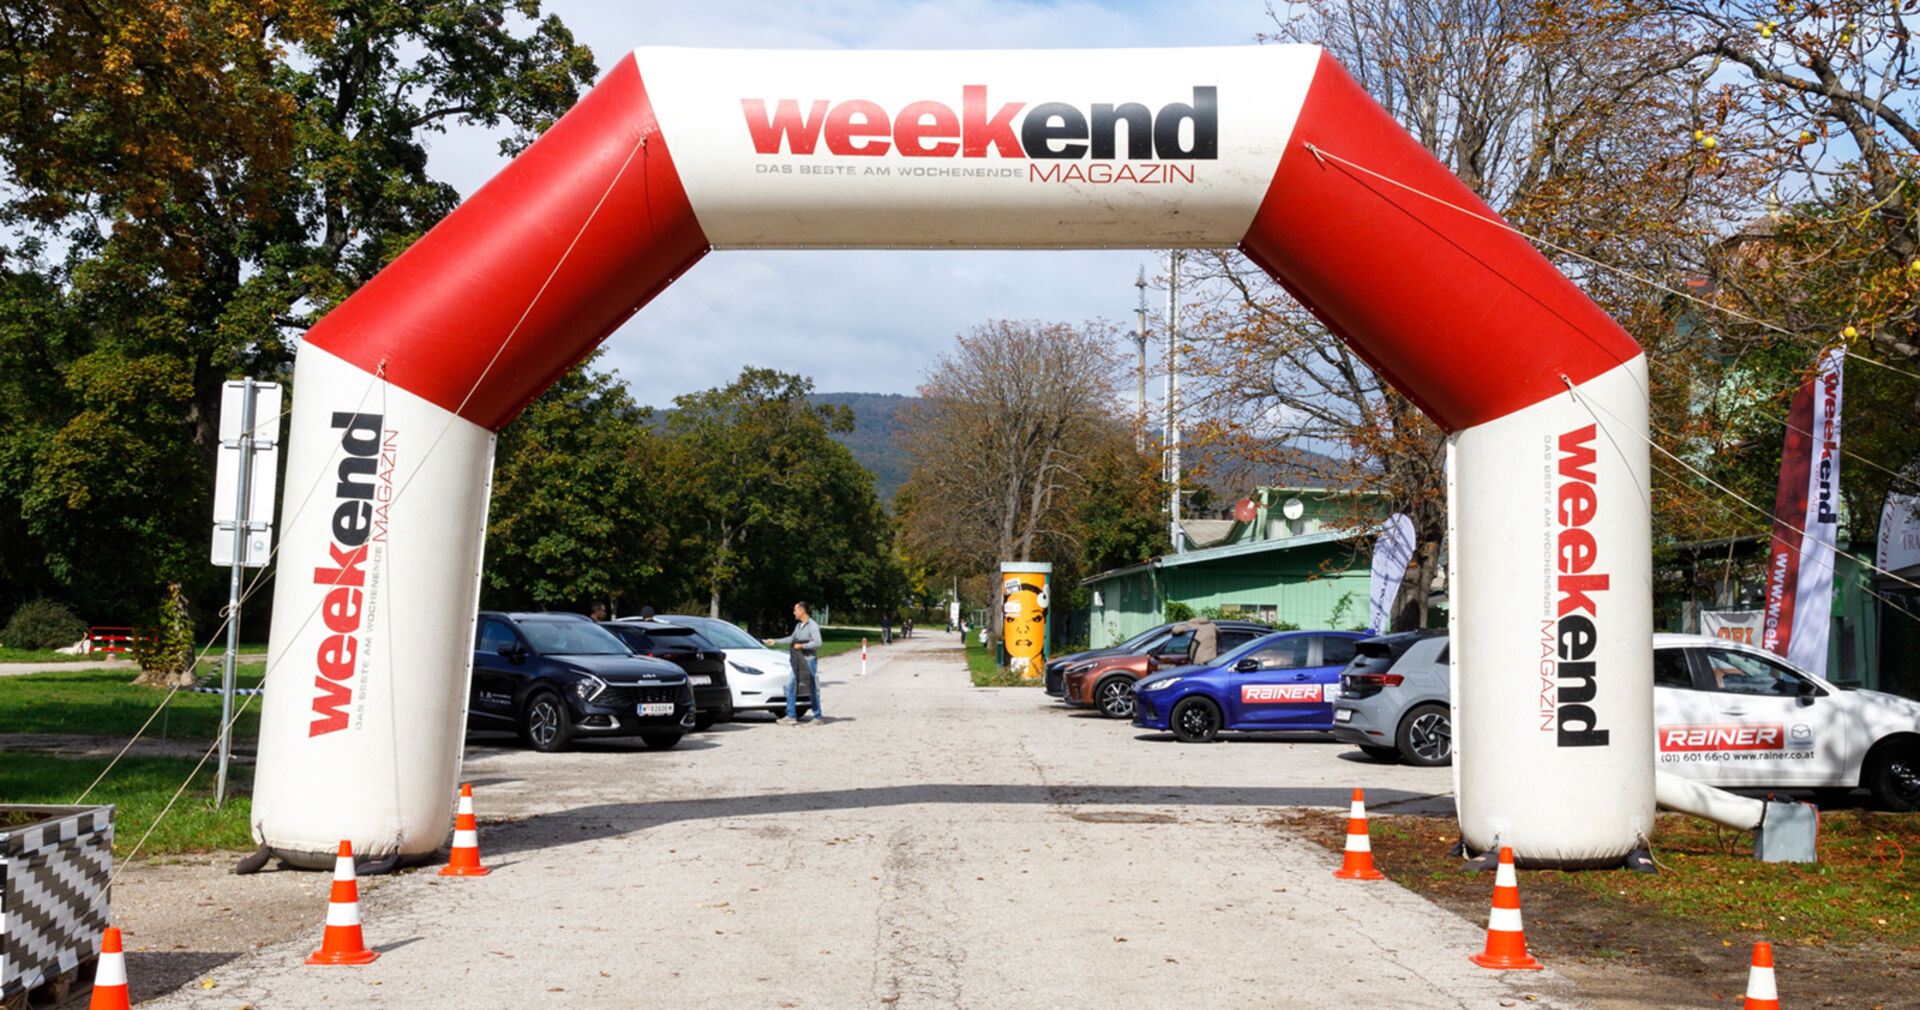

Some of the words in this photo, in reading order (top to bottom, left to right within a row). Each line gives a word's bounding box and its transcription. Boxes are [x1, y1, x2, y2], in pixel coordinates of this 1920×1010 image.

[740, 84, 1218, 160] weekend
[756, 164, 793, 174] DAS
[800, 165, 857, 175] BESTE
[863, 166, 891, 176] AM
[898, 167, 1024, 177] WOCHENENDE
[1029, 163, 1195, 184] MAGAZIN
[372, 429, 399, 543] MAGAZIN
[1818, 372, 1837, 524] weekend
[1543, 508, 1551, 527] AM
[308, 411, 384, 738] weekend
[366, 546, 382, 633] WOCHENENDE
[1557, 423, 1610, 748] weekend
[1764, 552, 1788, 651] www.week
[359, 660, 370, 701] BESTE
[363, 637, 373, 657] AM
[1540, 619, 1555, 731] MAGAZIN
[355, 704, 365, 731] DAS
[1660, 752, 1680, 763] (01)
[1683, 752, 1702, 762] 601
[1705, 751, 1731, 761] 66-0
[1733, 750, 1815, 761] www.rainer.co.at
